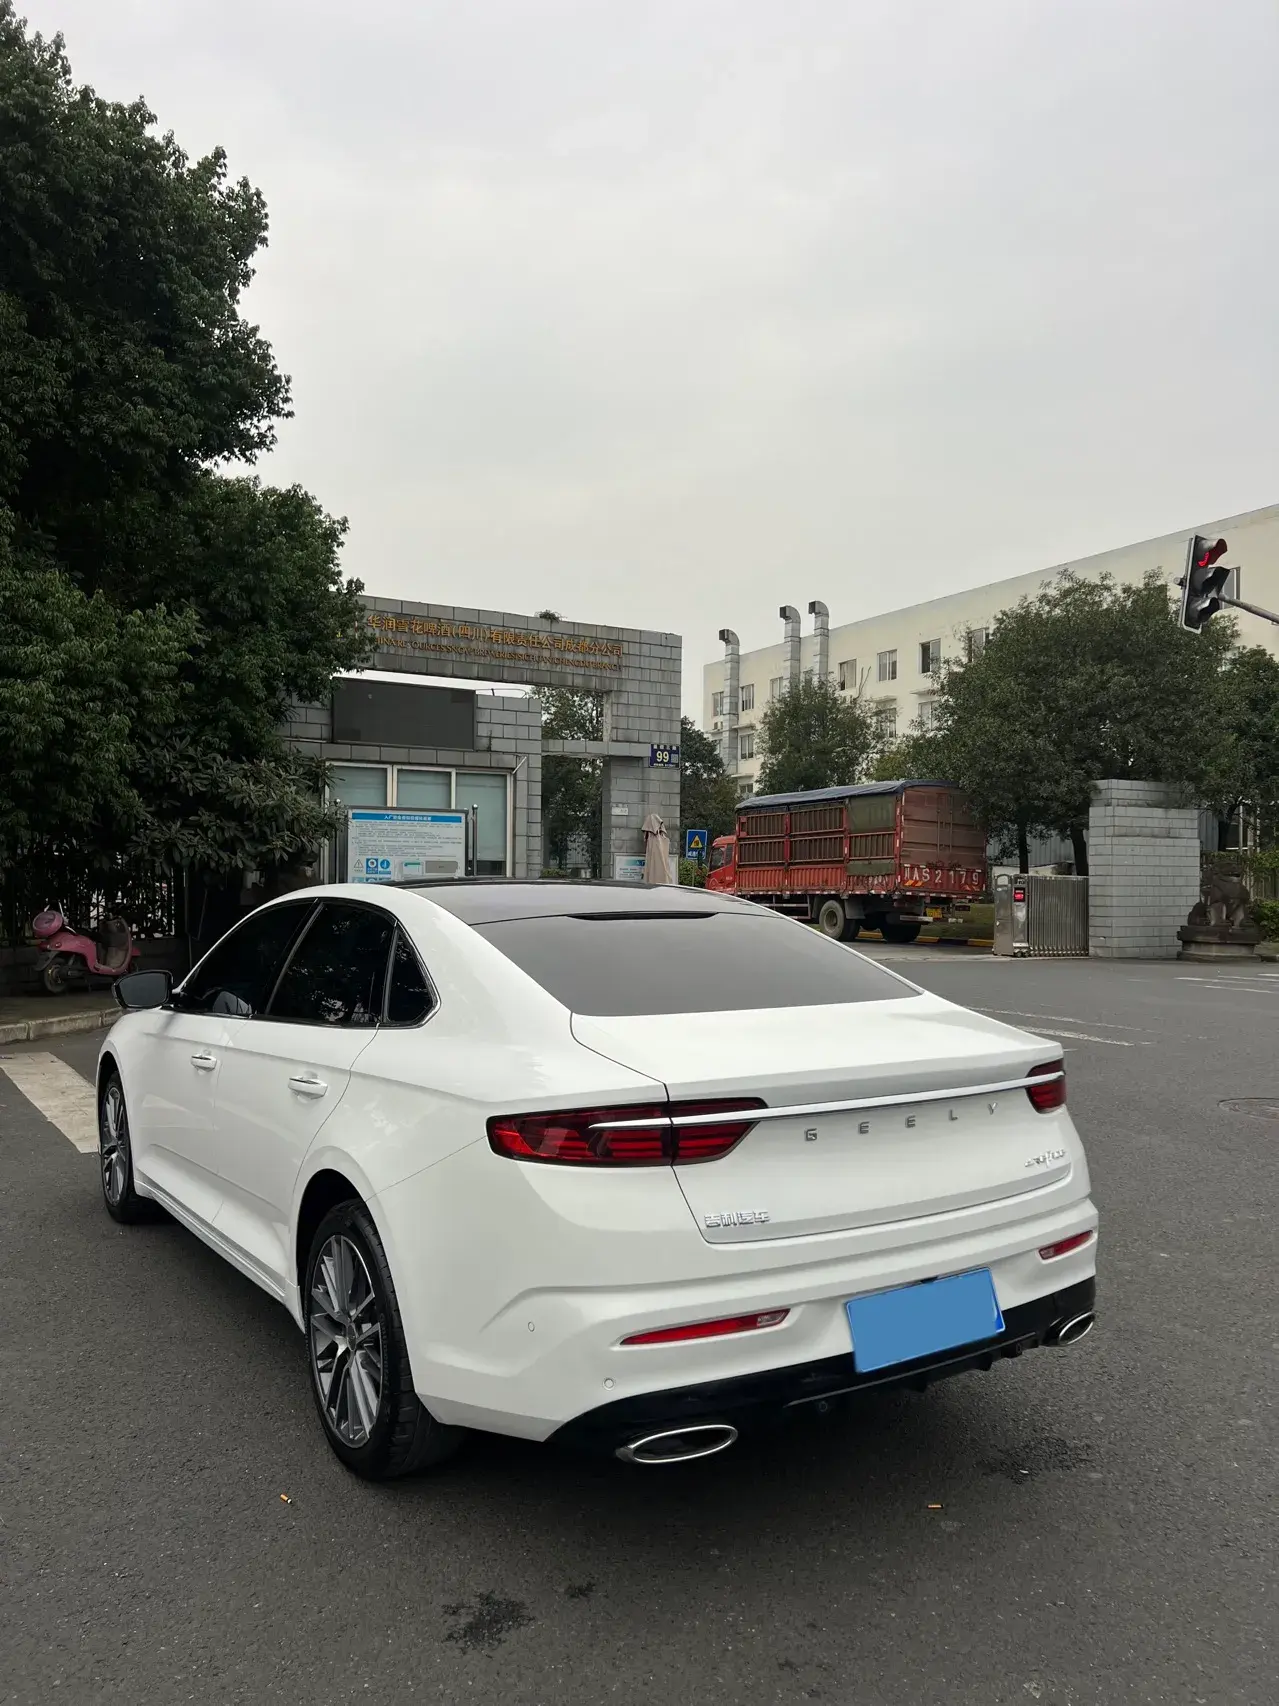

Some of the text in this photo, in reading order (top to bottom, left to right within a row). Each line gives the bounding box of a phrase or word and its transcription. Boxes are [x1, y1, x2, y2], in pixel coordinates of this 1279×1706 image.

[656, 750, 670, 763] 99
[804, 1101, 999, 1143] GEELY
[704, 1209, 771, 1228] 吉利汽车
